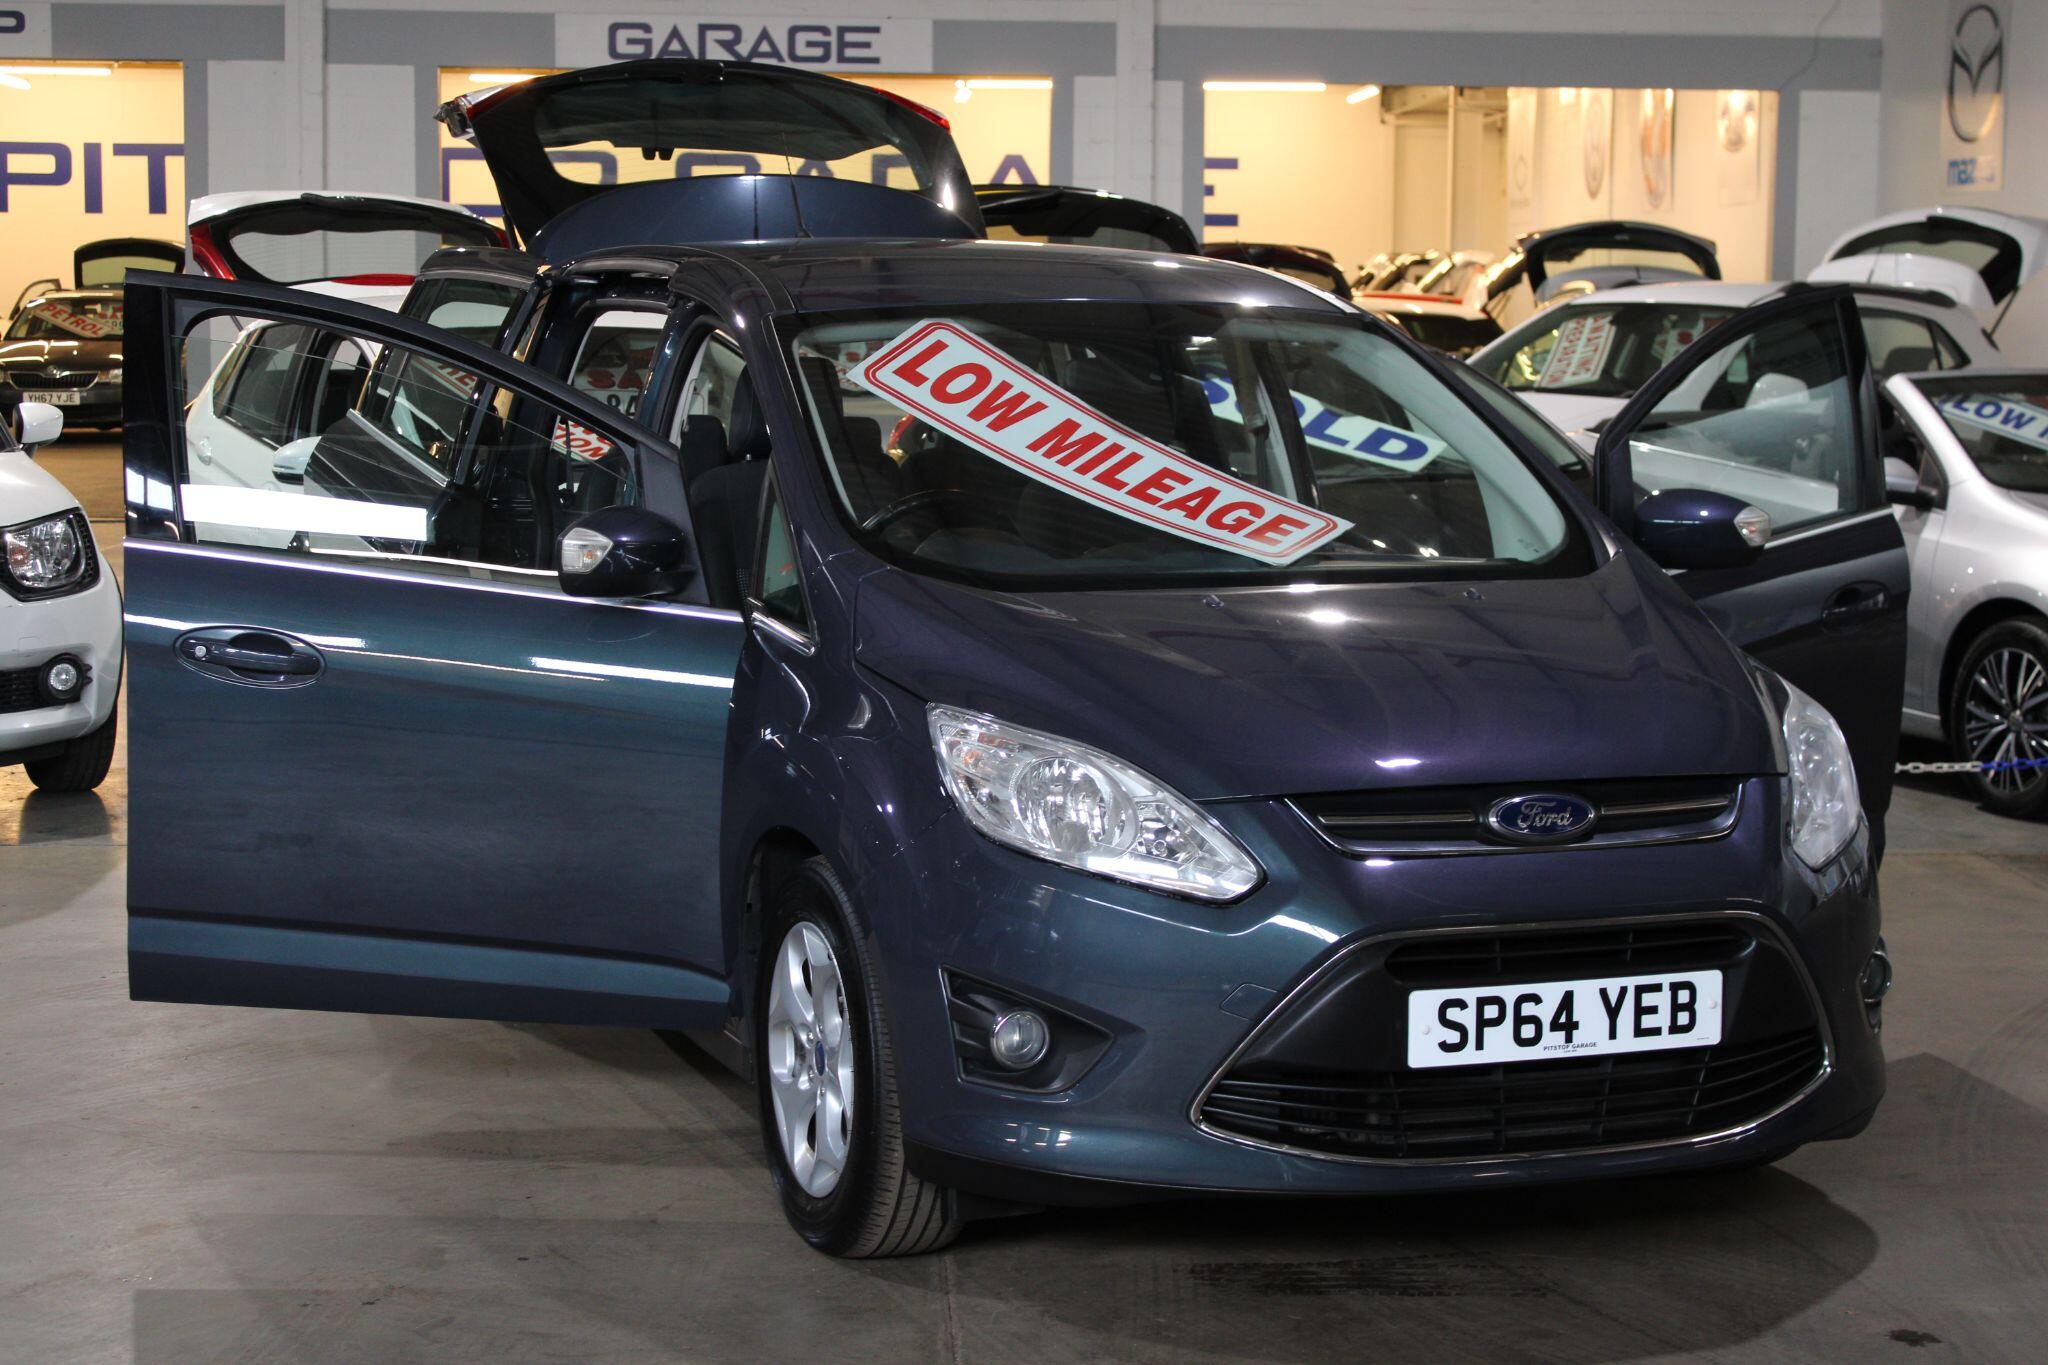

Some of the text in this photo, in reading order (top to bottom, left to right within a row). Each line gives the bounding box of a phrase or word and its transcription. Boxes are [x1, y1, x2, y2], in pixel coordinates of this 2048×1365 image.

[608, 22, 881, 64] GARAGE
[41, 303, 103, 336] PETROL
[28, 393, 76, 403] YH67 YJE
[1952, 393, 2038, 430] LOW
[892, 339, 1048, 431] LOW
[1026, 418, 1310, 546] MILEAGE
[1518, 802, 1572, 828] Ford
[1437, 981, 1697, 1053] SP64 YEB
[1571, 1041, 1598, 1049] GARAGE
